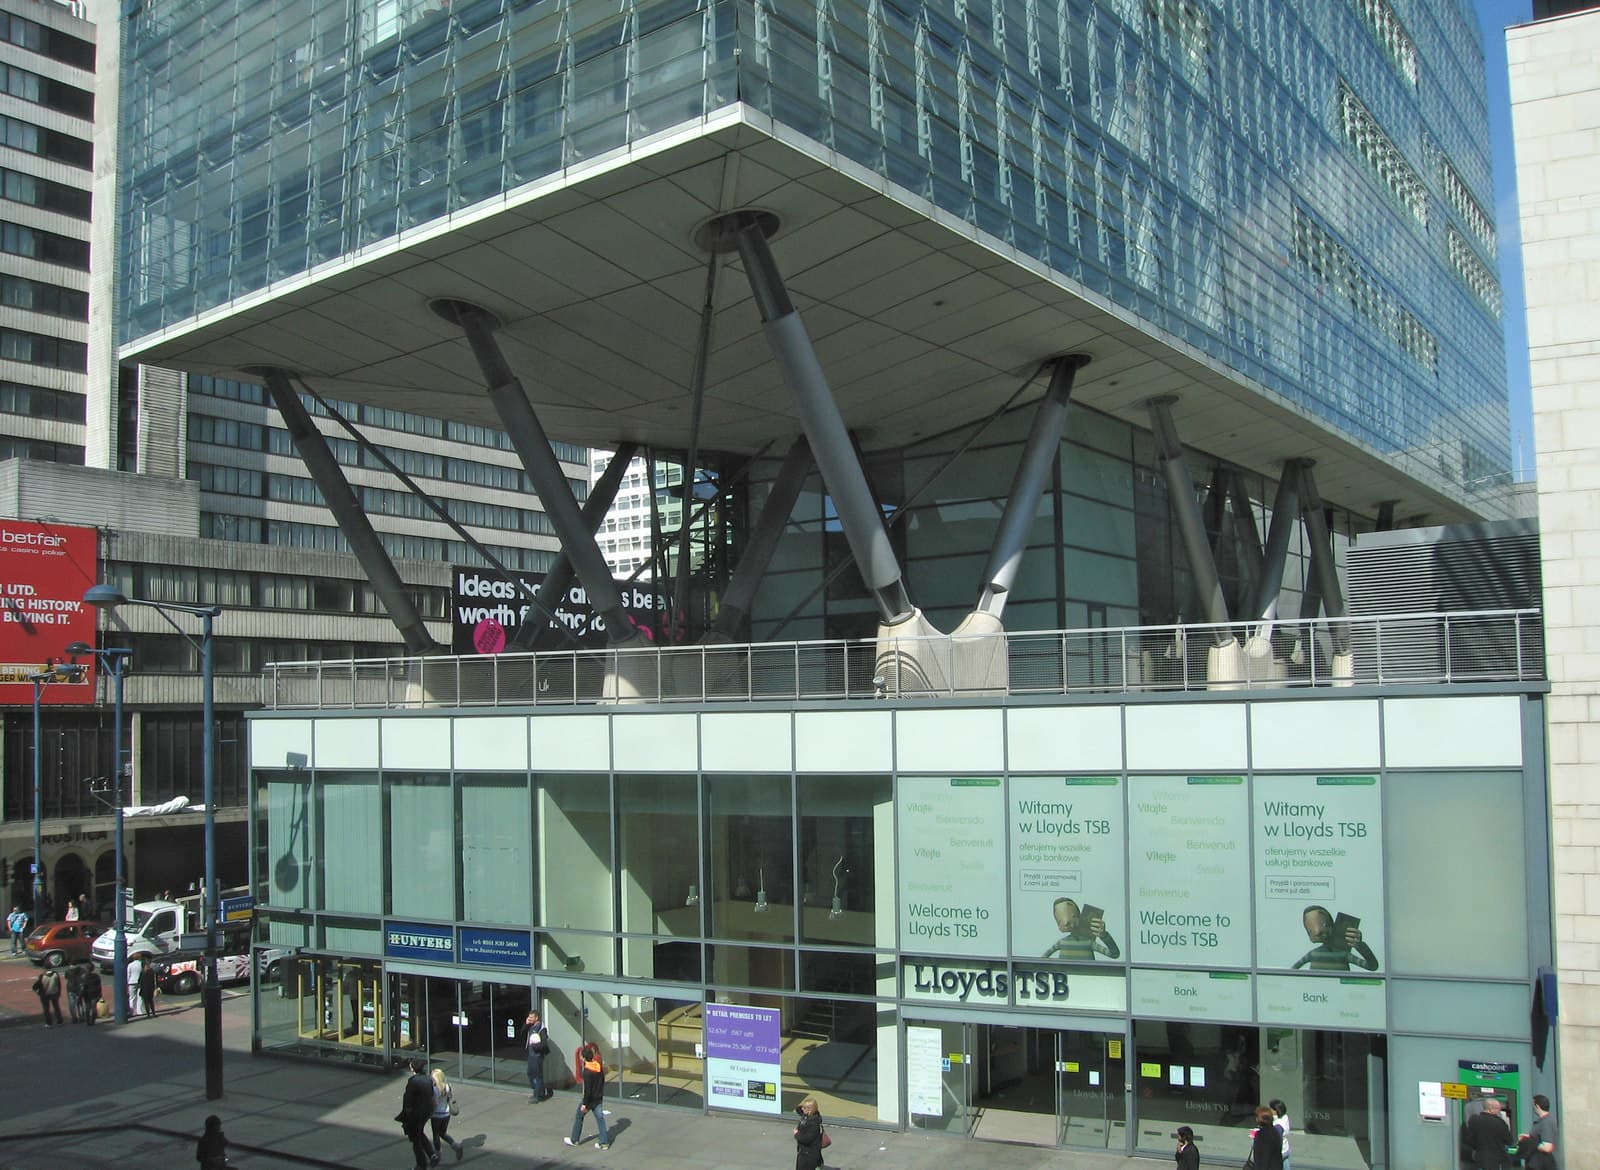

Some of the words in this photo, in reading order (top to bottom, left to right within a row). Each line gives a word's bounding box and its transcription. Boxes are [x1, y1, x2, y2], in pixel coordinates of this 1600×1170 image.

[2, 529, 67, 546] betfair
[7, 583, 38, 596] UTD.
[459, 573, 515, 600] Ideas
[28, 599, 84, 614] HISTORY,
[458, 603, 516, 627] worth
[3, 611, 54, 624] BUYING
[57, 613, 71, 625] IT.
[1019, 800, 1073, 818] Witamy
[1264, 801, 1325, 820] Witamy
[1019, 822, 1032, 833] w
[1036, 819, 1080, 837] Lloyds
[1084, 820, 1110, 834] TSB
[1264, 825, 1279, 837] w
[1283, 821, 1334, 840] Lloyds
[1338, 822, 1367, 838] TSB
[1292, 858, 1333, 868] bankowe
[908, 903, 973, 919] Welcome
[976, 906, 989, 920] to
[1139, 910, 1211, 927] Welcome
[1216, 913, 1231, 928] to
[909, 921, 951, 939] Lloyds
[953, 923, 978, 938] TSB
[389, 933, 452, 949] HUNTERS
[1140, 930, 1187, 949] Lloyds
[1191, 932, 1218, 947] TSB
[914, 963, 1008, 1001] Lloyds
[1015, 970, 1069, 1000] TSB
[1174, 985, 1198, 997] Bank
[1302, 992, 1328, 1003] Bank
[1471, 1062, 1505, 1072] cashpoint
